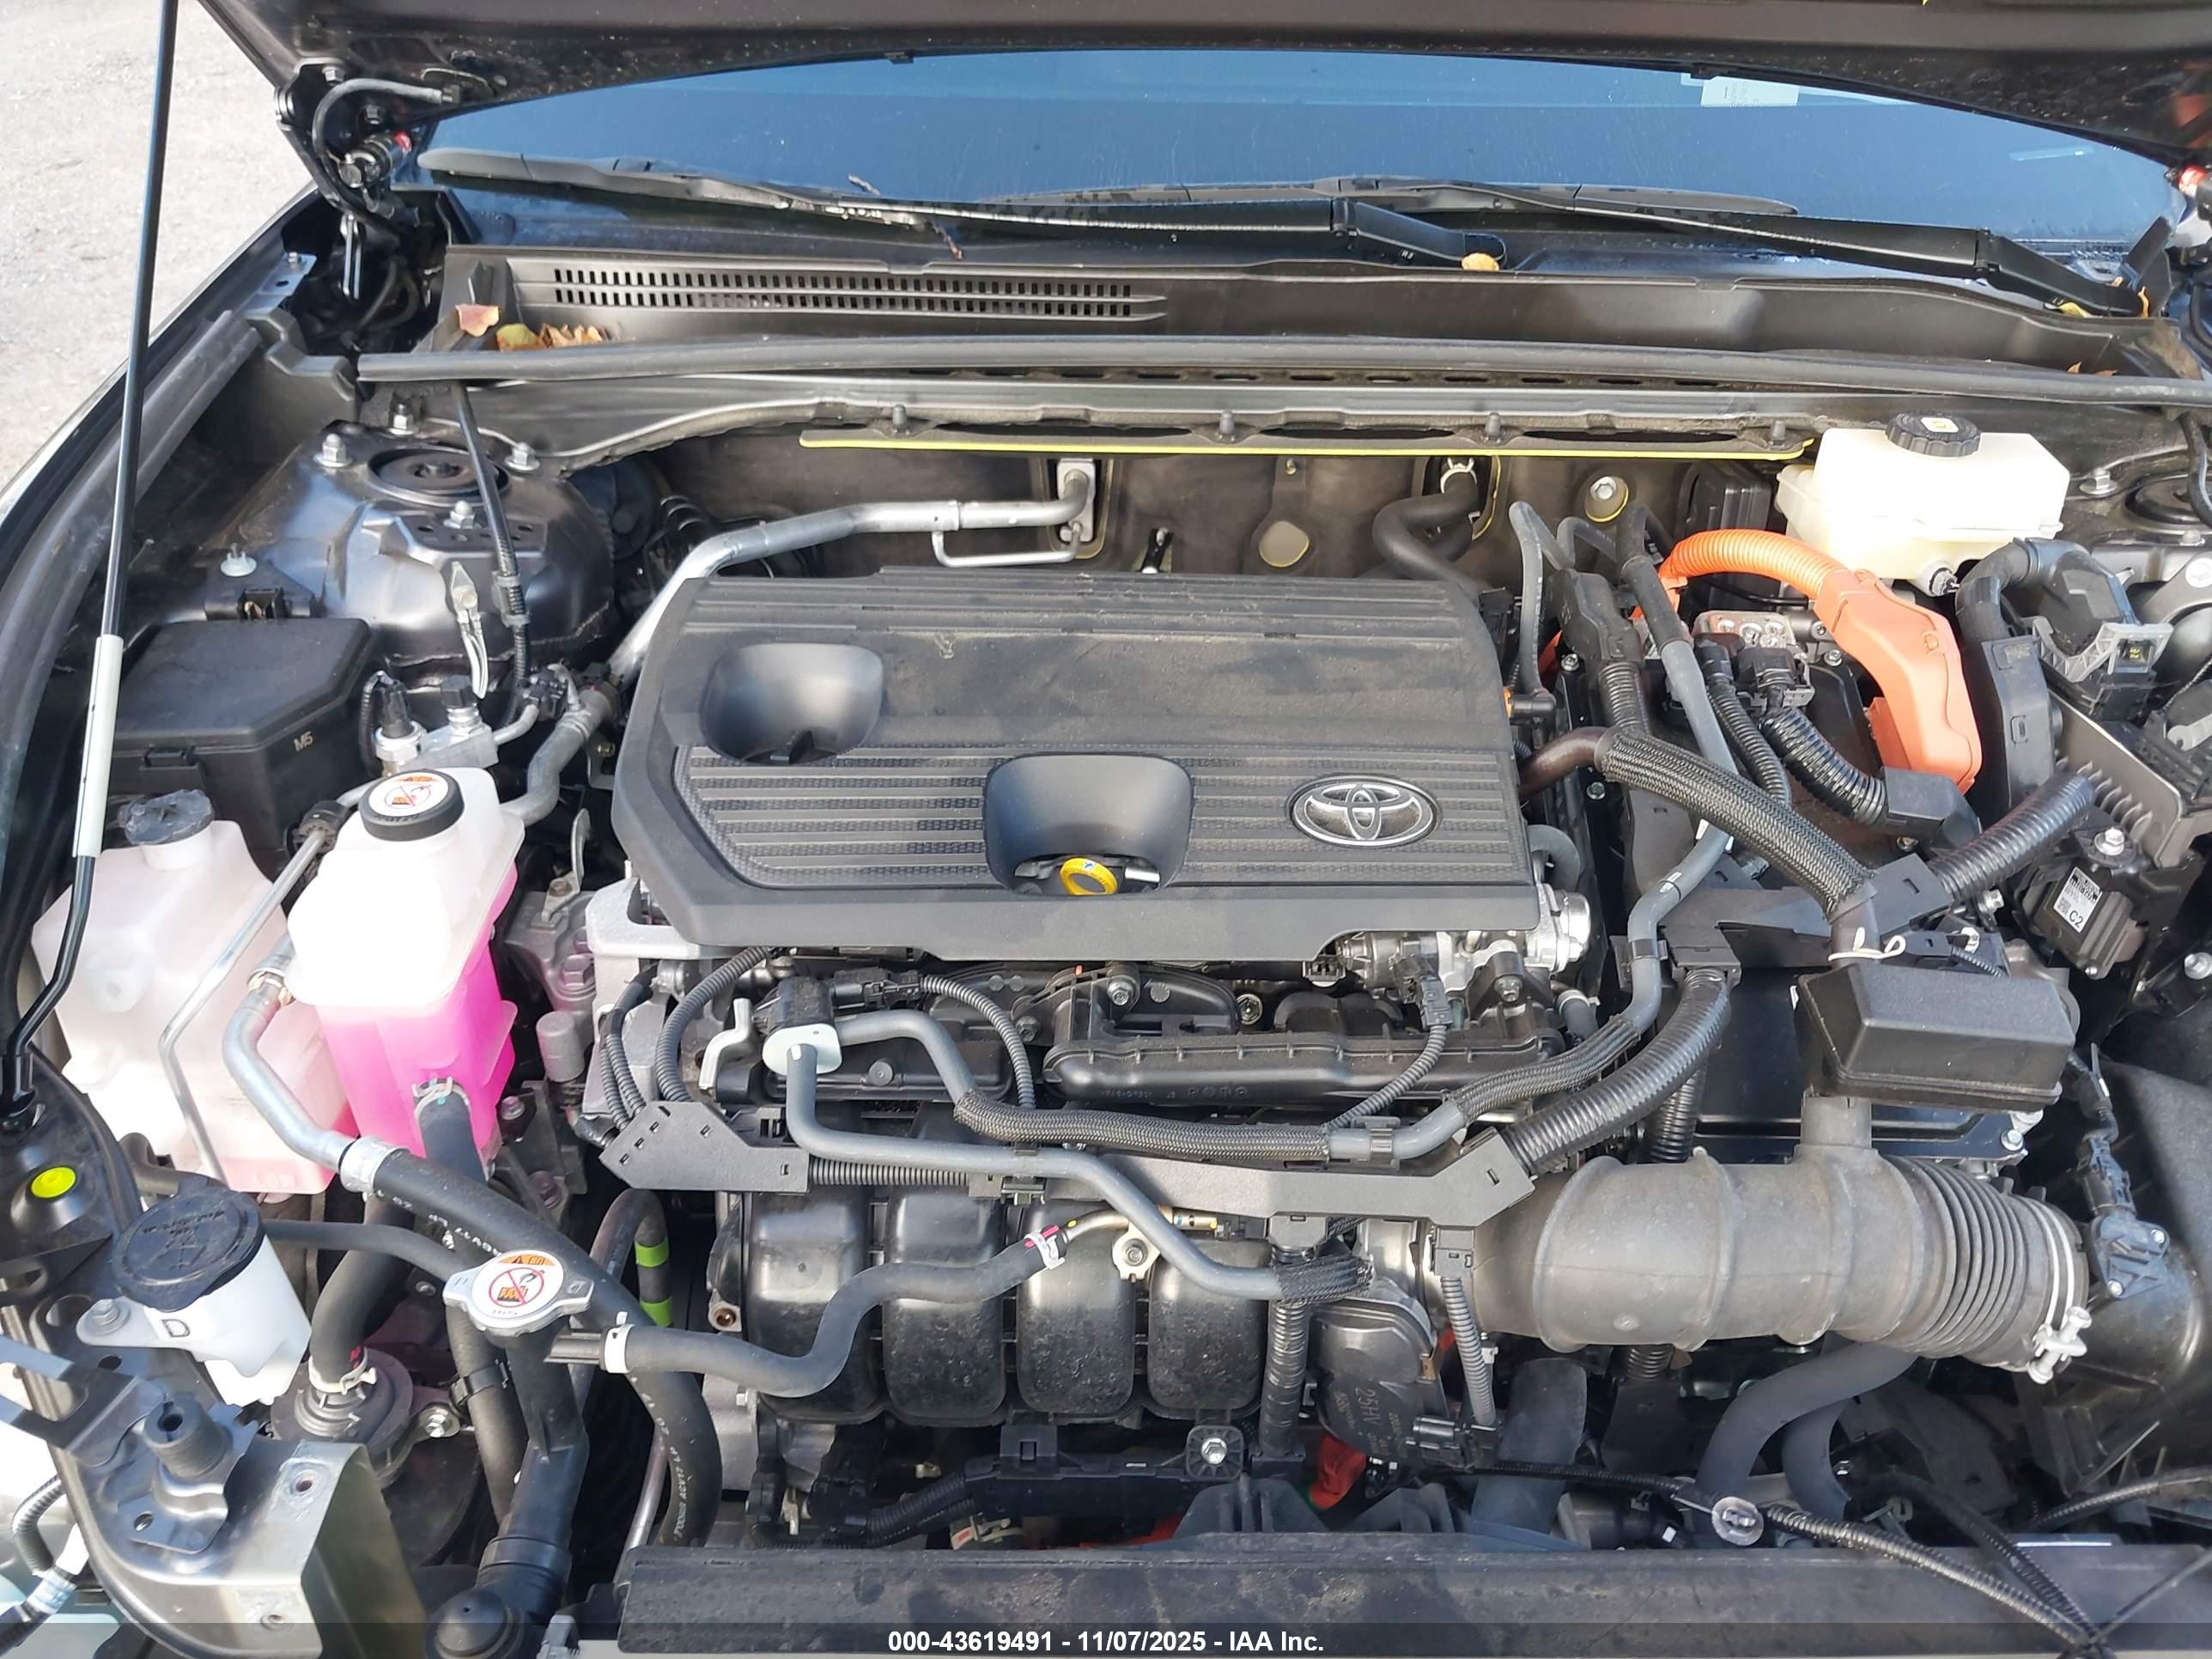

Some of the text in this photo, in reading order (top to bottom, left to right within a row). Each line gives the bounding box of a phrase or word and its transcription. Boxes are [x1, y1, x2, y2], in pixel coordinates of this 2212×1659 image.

[294, 731, 313, 752] M5
[2069, 910, 2083, 928] C2
[161, 1318, 191, 1338] D
[1354, 1387, 1382, 1426] 25HV
